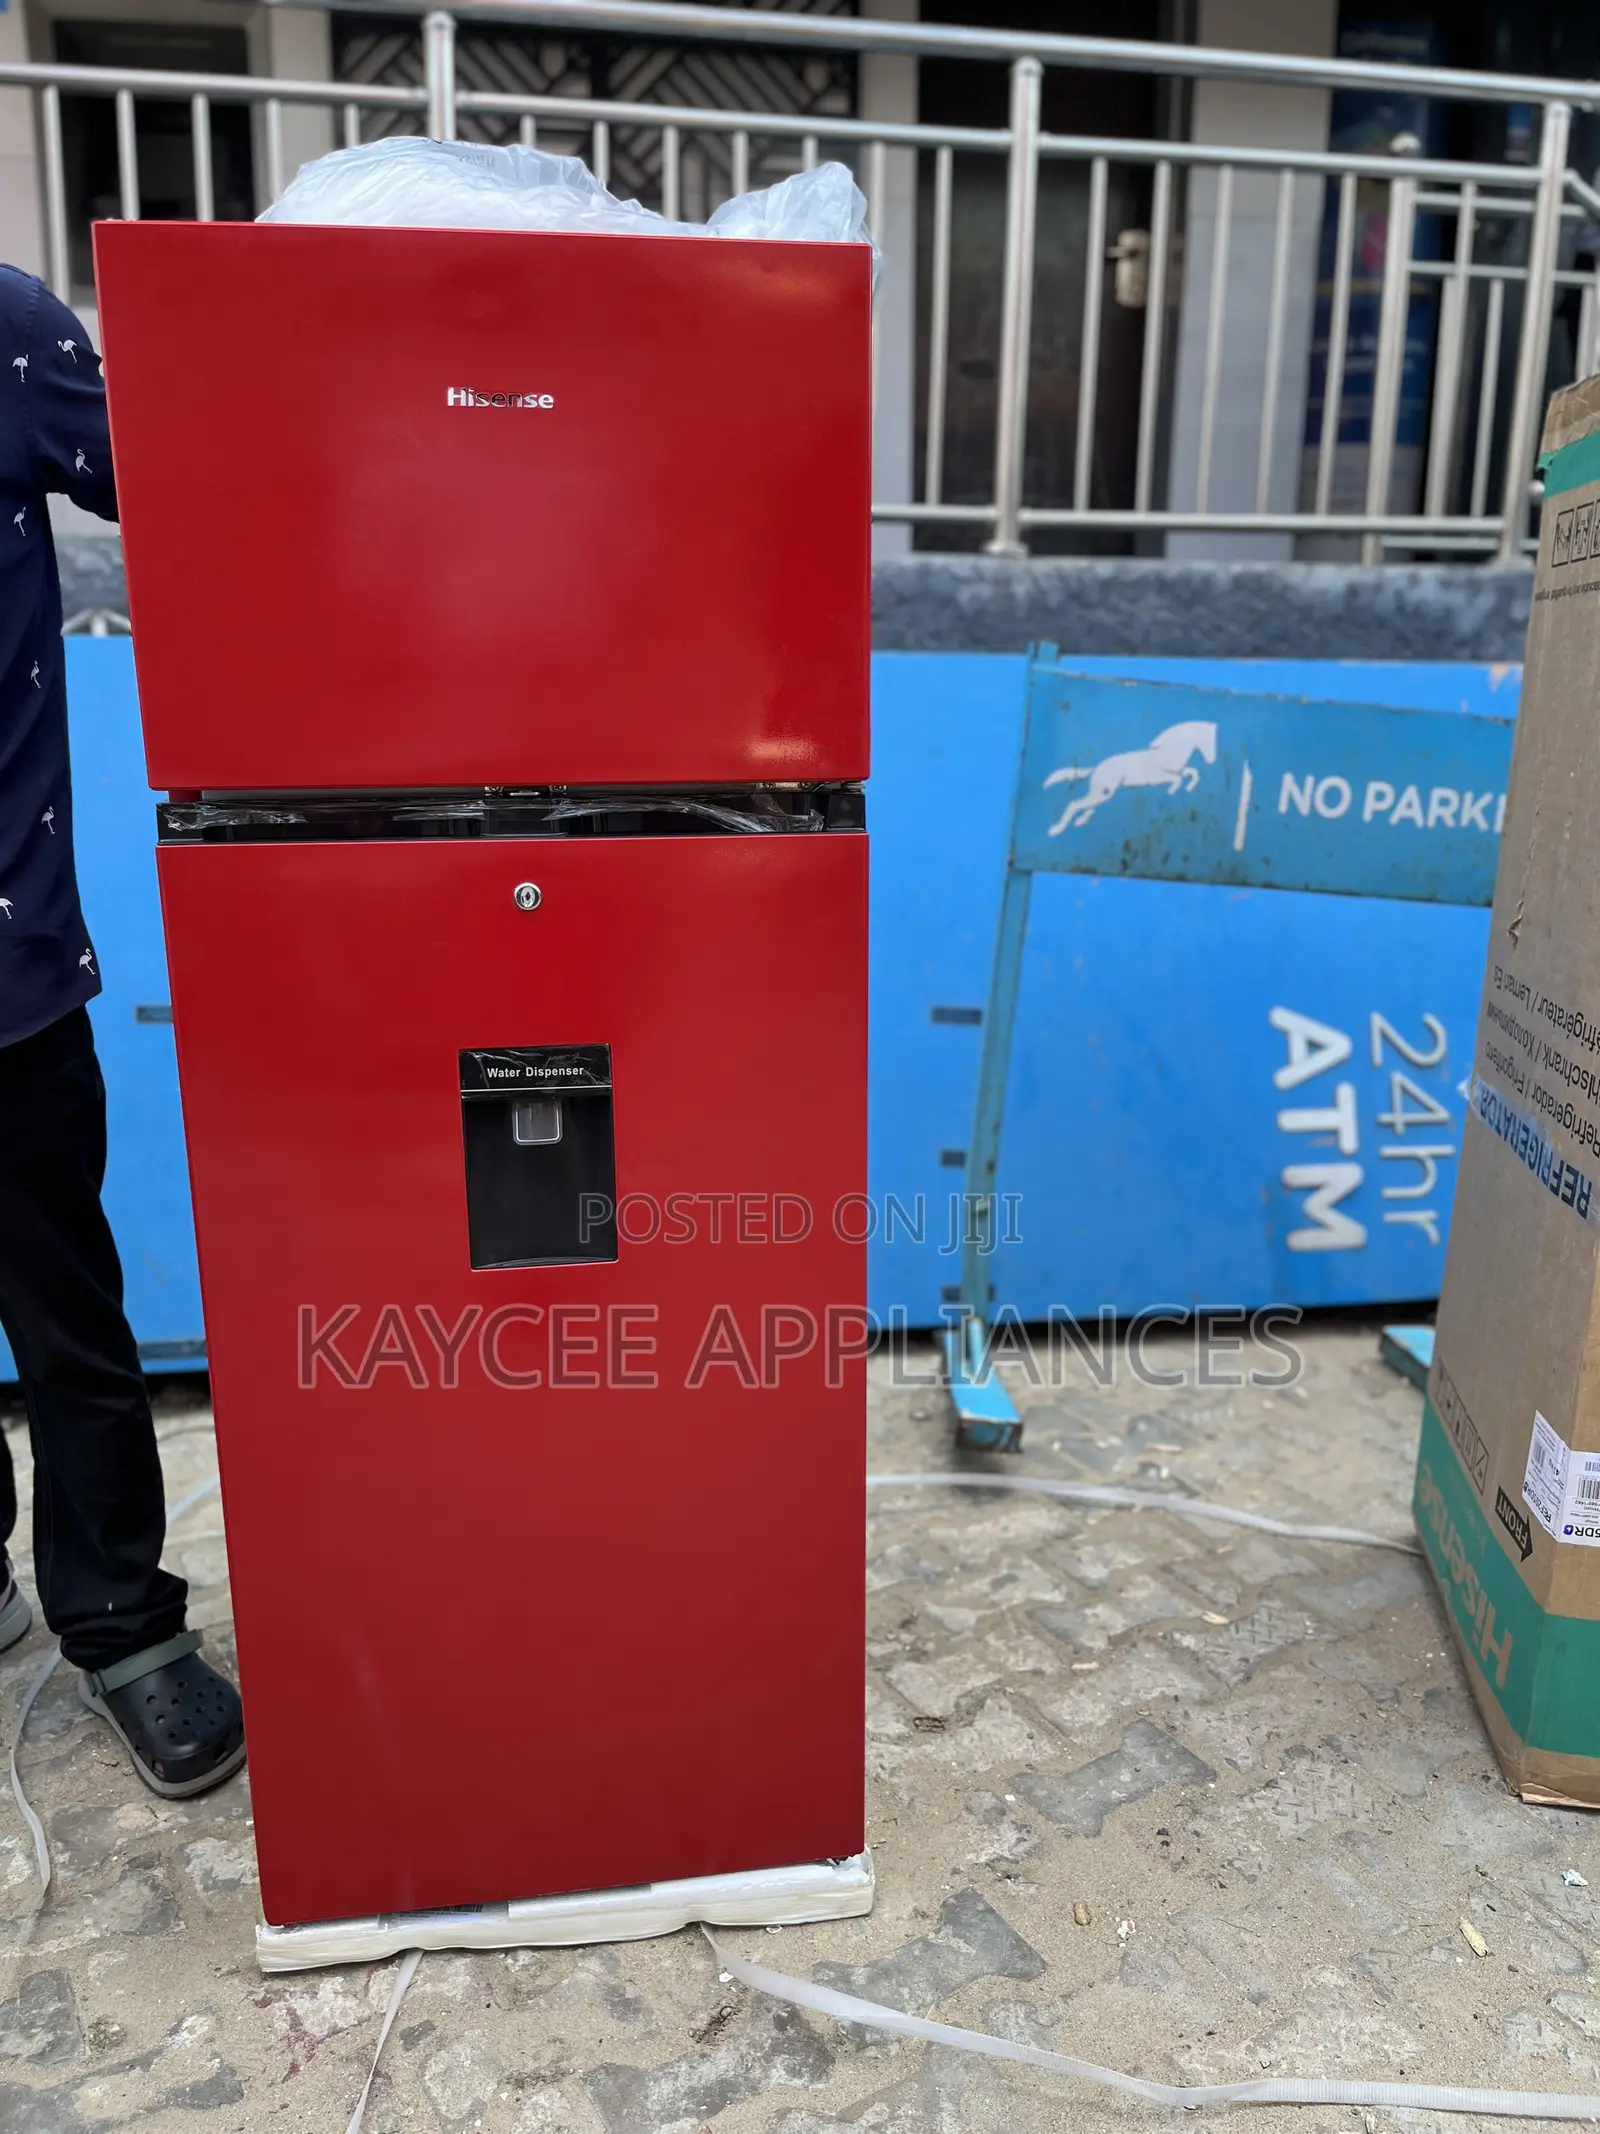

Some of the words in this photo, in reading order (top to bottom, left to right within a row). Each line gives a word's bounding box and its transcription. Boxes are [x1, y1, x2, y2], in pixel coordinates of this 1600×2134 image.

[447, 386, 555, 409] Hisense
[1278, 772, 1352, 818] NO
[487, 1067, 520, 1078] Water
[526, 1066, 584, 1079] Dispenser
[1268, 1005, 1368, 1252] ATM
[1369, 1010, 1456, 1246] 24hr
[1480, 1088, 1592, 1220] REFRIGERATOR
[1497, 1494, 1528, 1550] FRONT
[1419, 1460, 1513, 1690] Hisense
